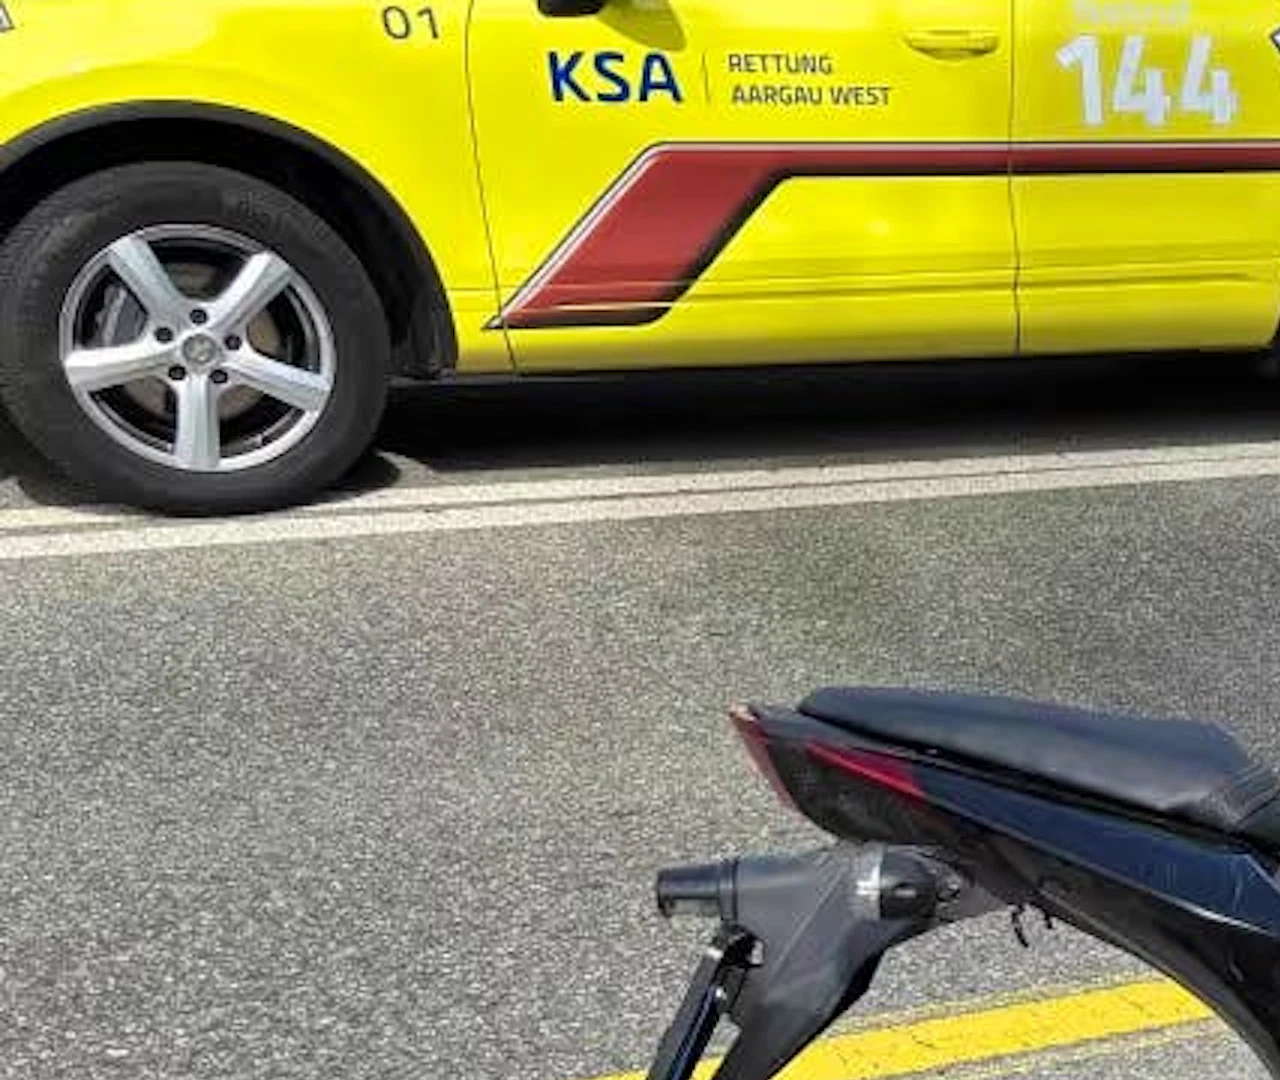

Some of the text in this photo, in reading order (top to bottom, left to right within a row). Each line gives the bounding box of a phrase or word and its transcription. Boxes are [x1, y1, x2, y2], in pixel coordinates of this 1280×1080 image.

[382, 6, 438, 39] 01
[547, 50, 683, 103] KSA
[728, 53, 833, 75] RETTUNG
[1055, 34, 1239, 125] 144
[731, 84, 891, 106] AARGAU WEST
